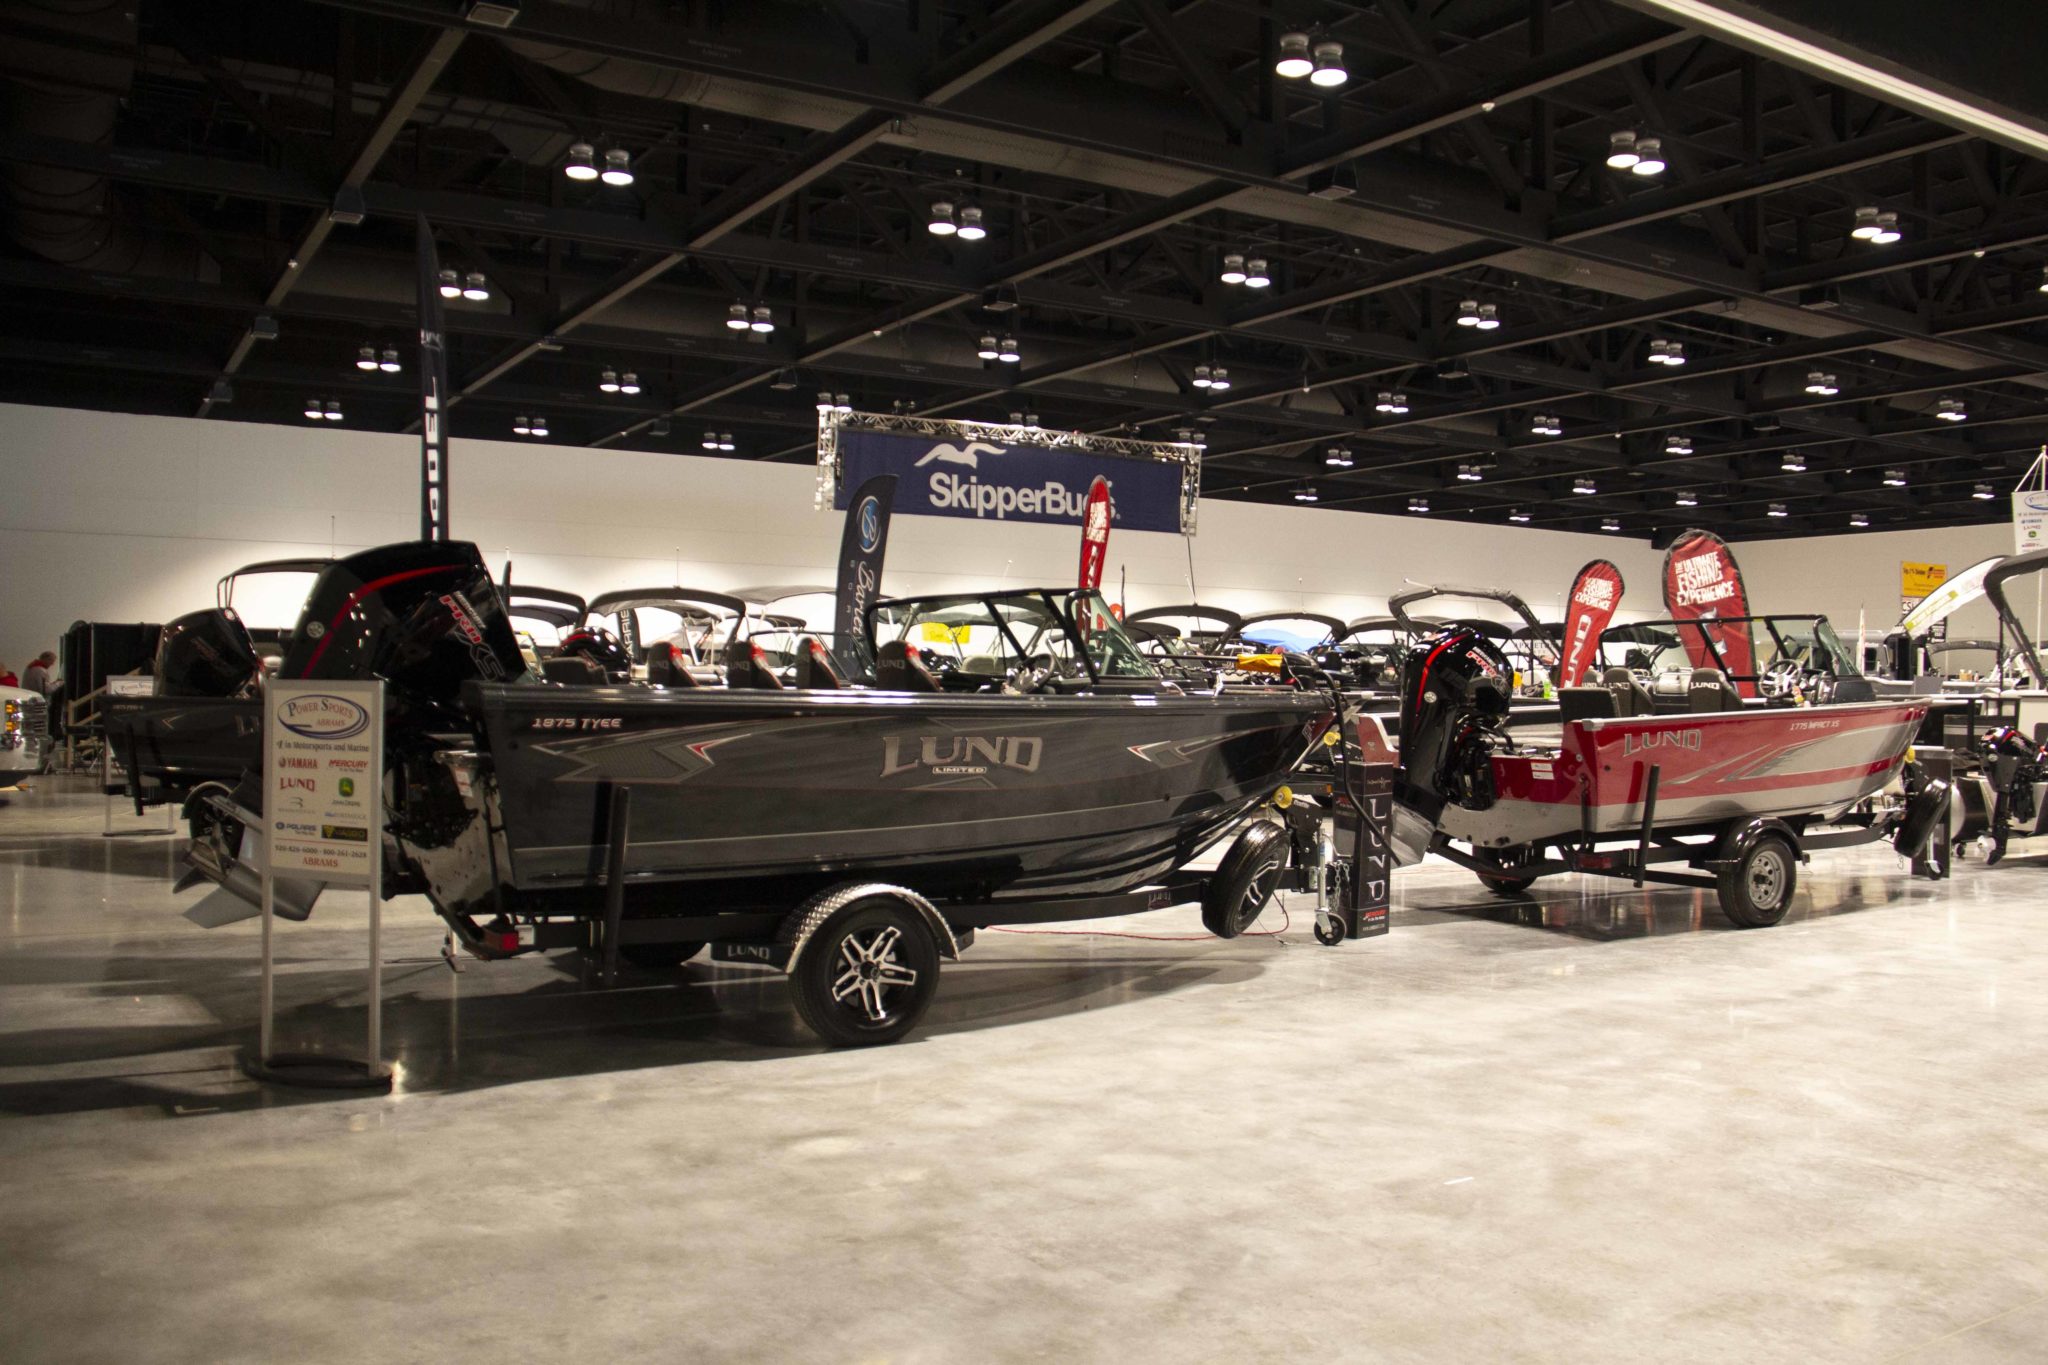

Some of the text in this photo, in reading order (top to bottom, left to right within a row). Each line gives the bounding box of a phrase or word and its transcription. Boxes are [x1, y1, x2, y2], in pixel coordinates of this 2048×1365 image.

[1683, 551, 1718, 573] ULTIMATE
[1677, 560, 1723, 594] FISHING
[1575, 591, 1611, 611] EXPERIENCE
[1676, 581, 1736, 607] EXPERIENCE
[1564, 614, 1592, 688] UND
[1690, 681, 1720, 690] LUND
[287, 698, 354, 719] POWER SPORTS
[532, 718, 622, 729] 1875 TYEE
[293, 741, 332, 752] Motorsports
[334, 743, 346, 751] and
[347, 743, 369, 752] Marine
[1622, 729, 1701, 758] LUND
[288, 758, 368, 769] YAMAHA MERCURY
[880, 736, 1043, 778] LUND
[933, 766, 986, 774] LIMITED
[280, 777, 316, 793] LUND
[1367, 798, 1387, 901] LUND
[303, 857, 339, 868] ABRAMS
[727, 945, 769, 960] LUND
